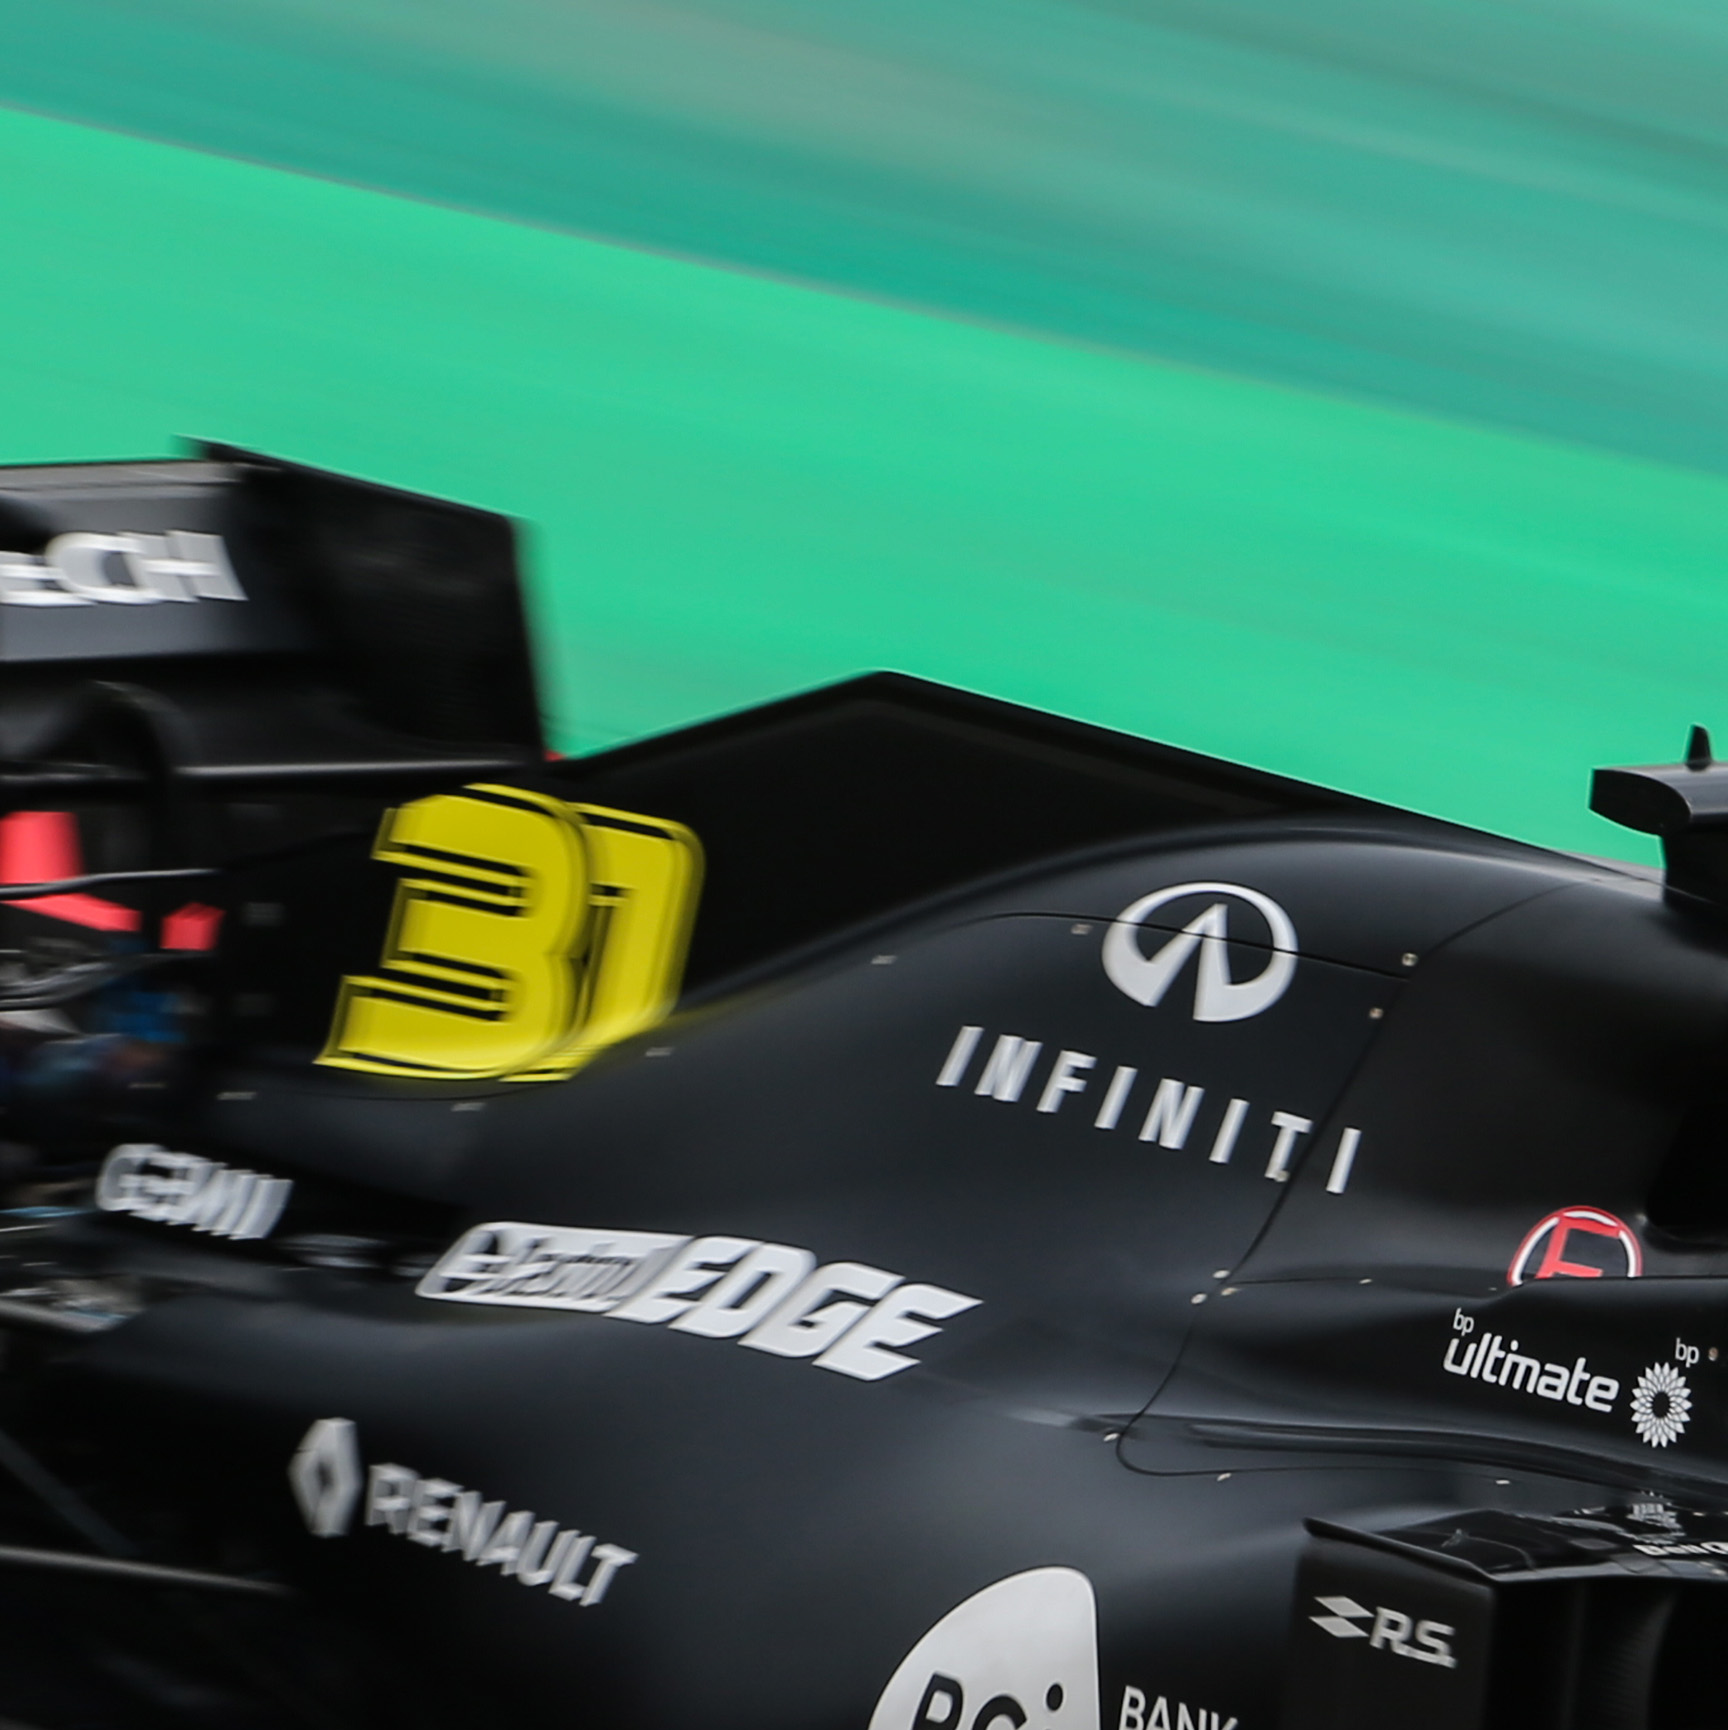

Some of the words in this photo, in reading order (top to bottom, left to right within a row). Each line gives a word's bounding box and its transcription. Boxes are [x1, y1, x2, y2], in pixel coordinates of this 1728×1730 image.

[312, 782, 706, 1083] 31
[936, 1024, 1362, 1194] INFINITI
[603, 1236, 984, 1382] EDGE
[1443, 1332, 1620, 1413] ultimate
[1452, 1307, 1475, 1337] bp
[1674, 1337, 1700, 1368] bp
[365, 1463, 639, 1607] RENAULT
